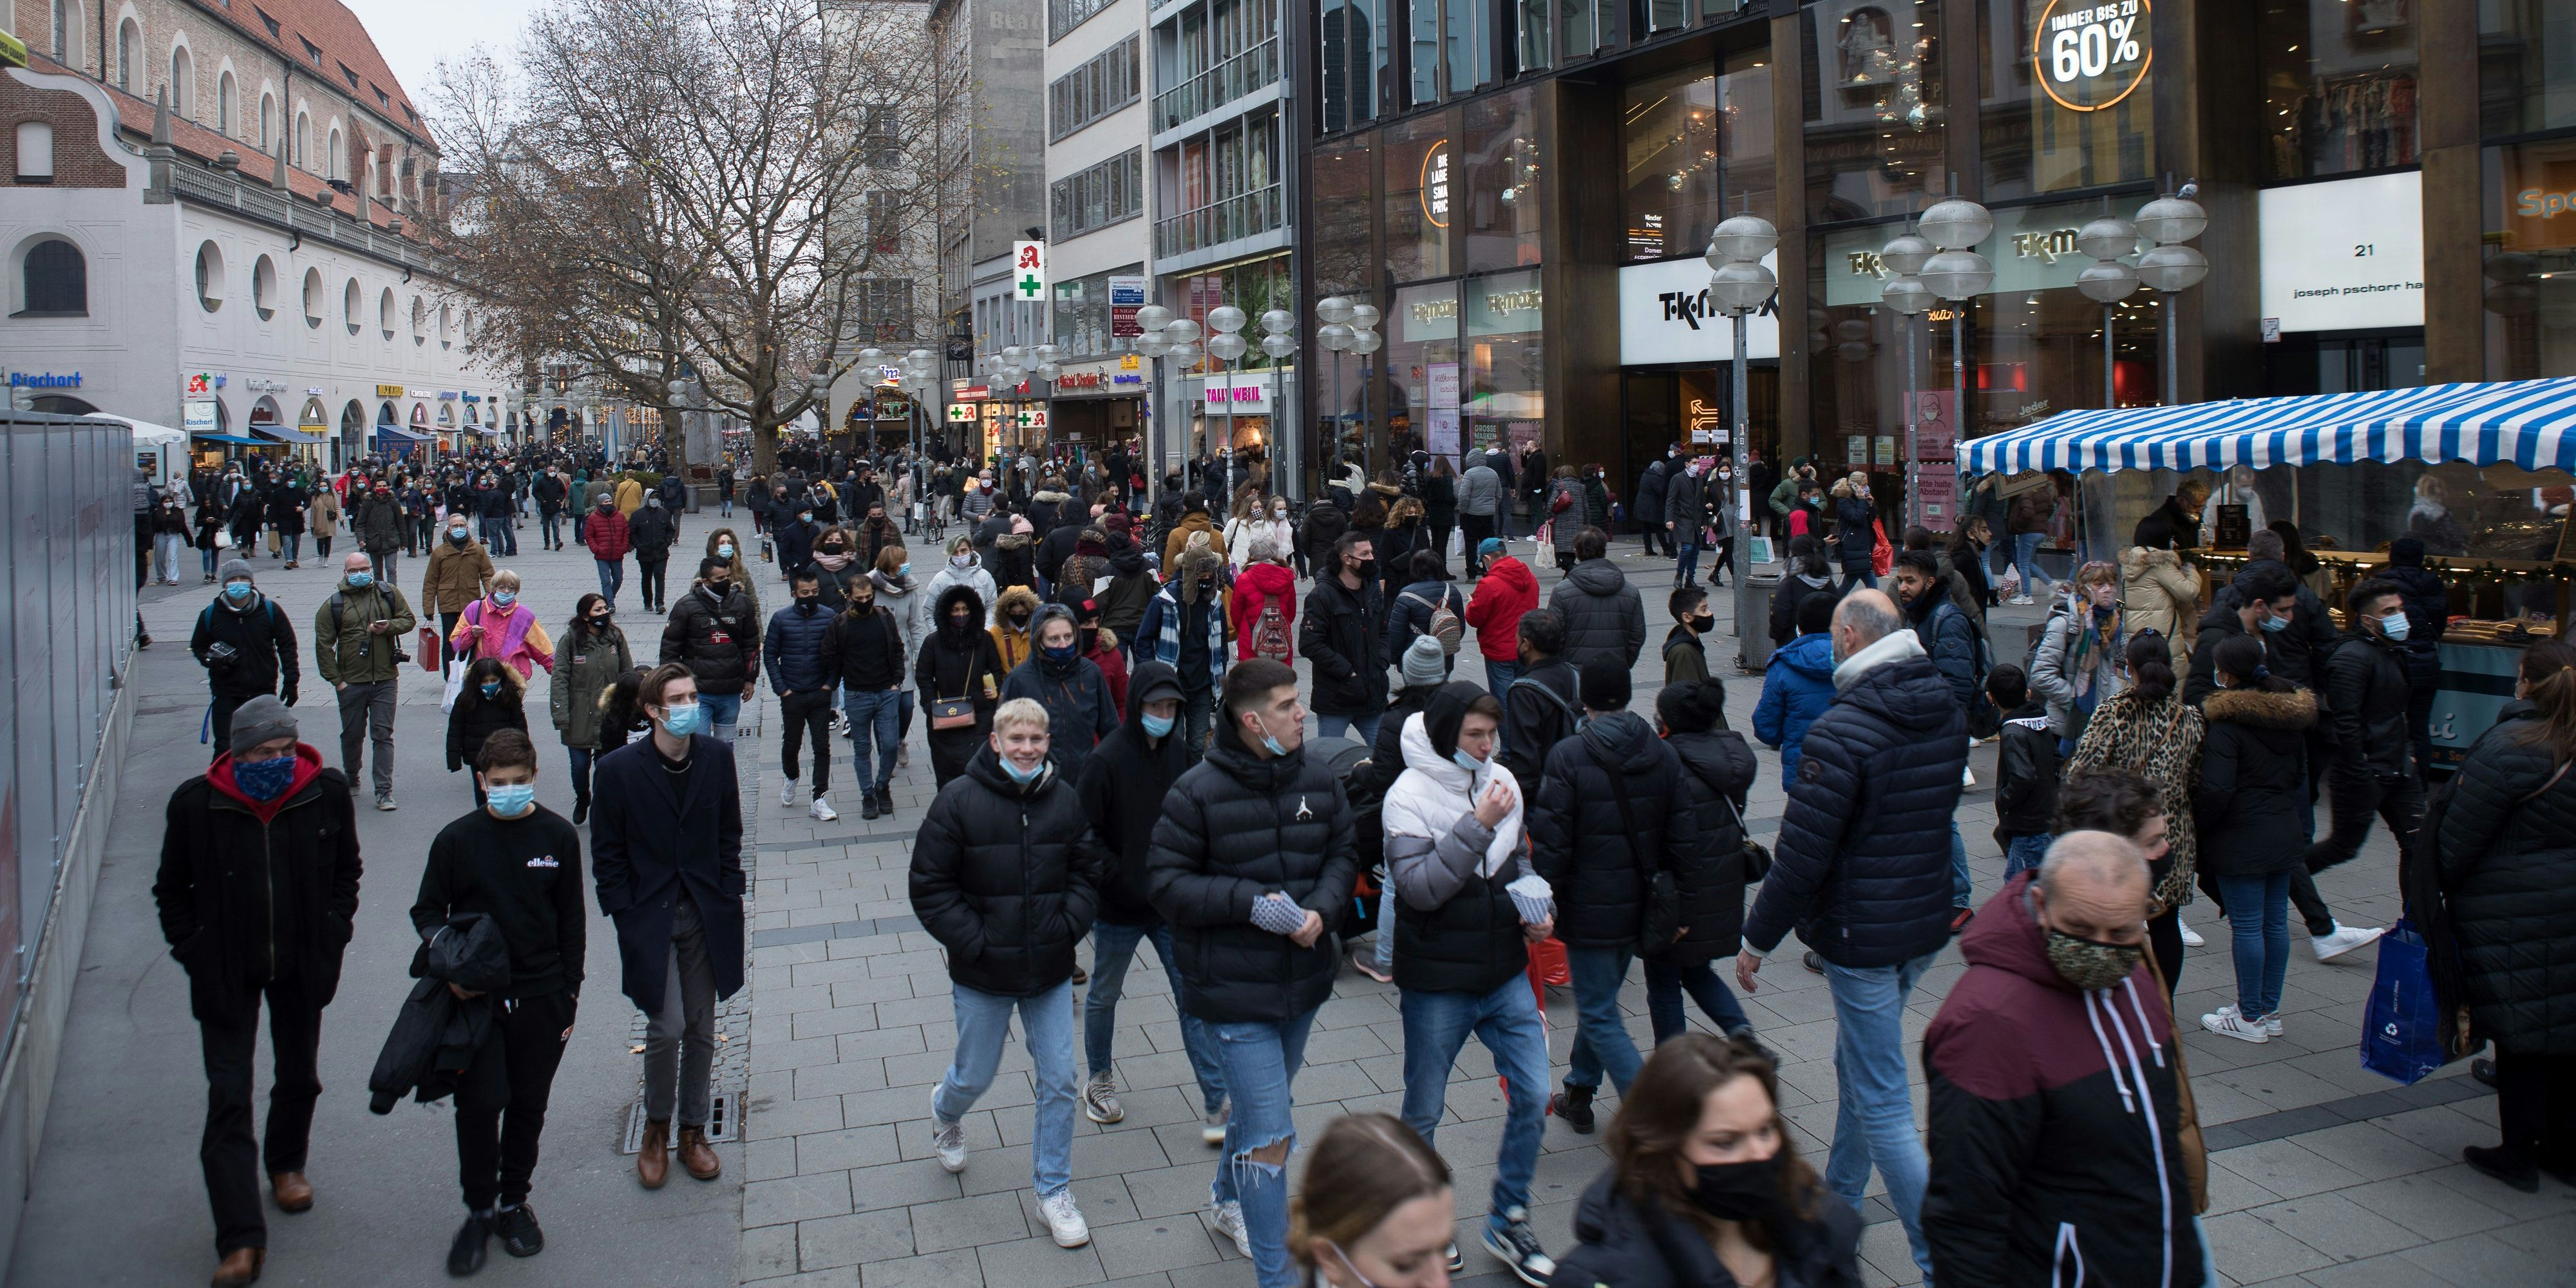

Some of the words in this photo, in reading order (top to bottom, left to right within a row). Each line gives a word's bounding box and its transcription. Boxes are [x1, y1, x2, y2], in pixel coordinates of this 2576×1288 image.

[2051, 10, 2093, 32] IMMER
[2096, 3, 2118, 22] BIS
[2121, 0, 2139, 17] ZU
[10, 47, 26, 63] GUARD
[2052, 15, 2139, 82] 60%
[1431, 169, 1448, 184] LABE
[1433, 185, 1448, 200] SMA
[1432, 199, 1448, 214] PRIC
[2354, 244, 2374, 257] 21
[2294, 287, 2338, 299] joseph
[2343, 284, 2401, 296] pschorr
[2405, 281, 2423, 290] ha
[11, 372, 82, 388] Rischart
[2019, 399, 2049, 416] Jeder
[1474, 424, 1497, 433] GROSSE
[1474, 432, 1497, 440] MARKEN
[1934, 480, 1952, 488] halte
[2022, 720, 2041, 729] TRUE
[527, 857, 559, 868] ellesse
